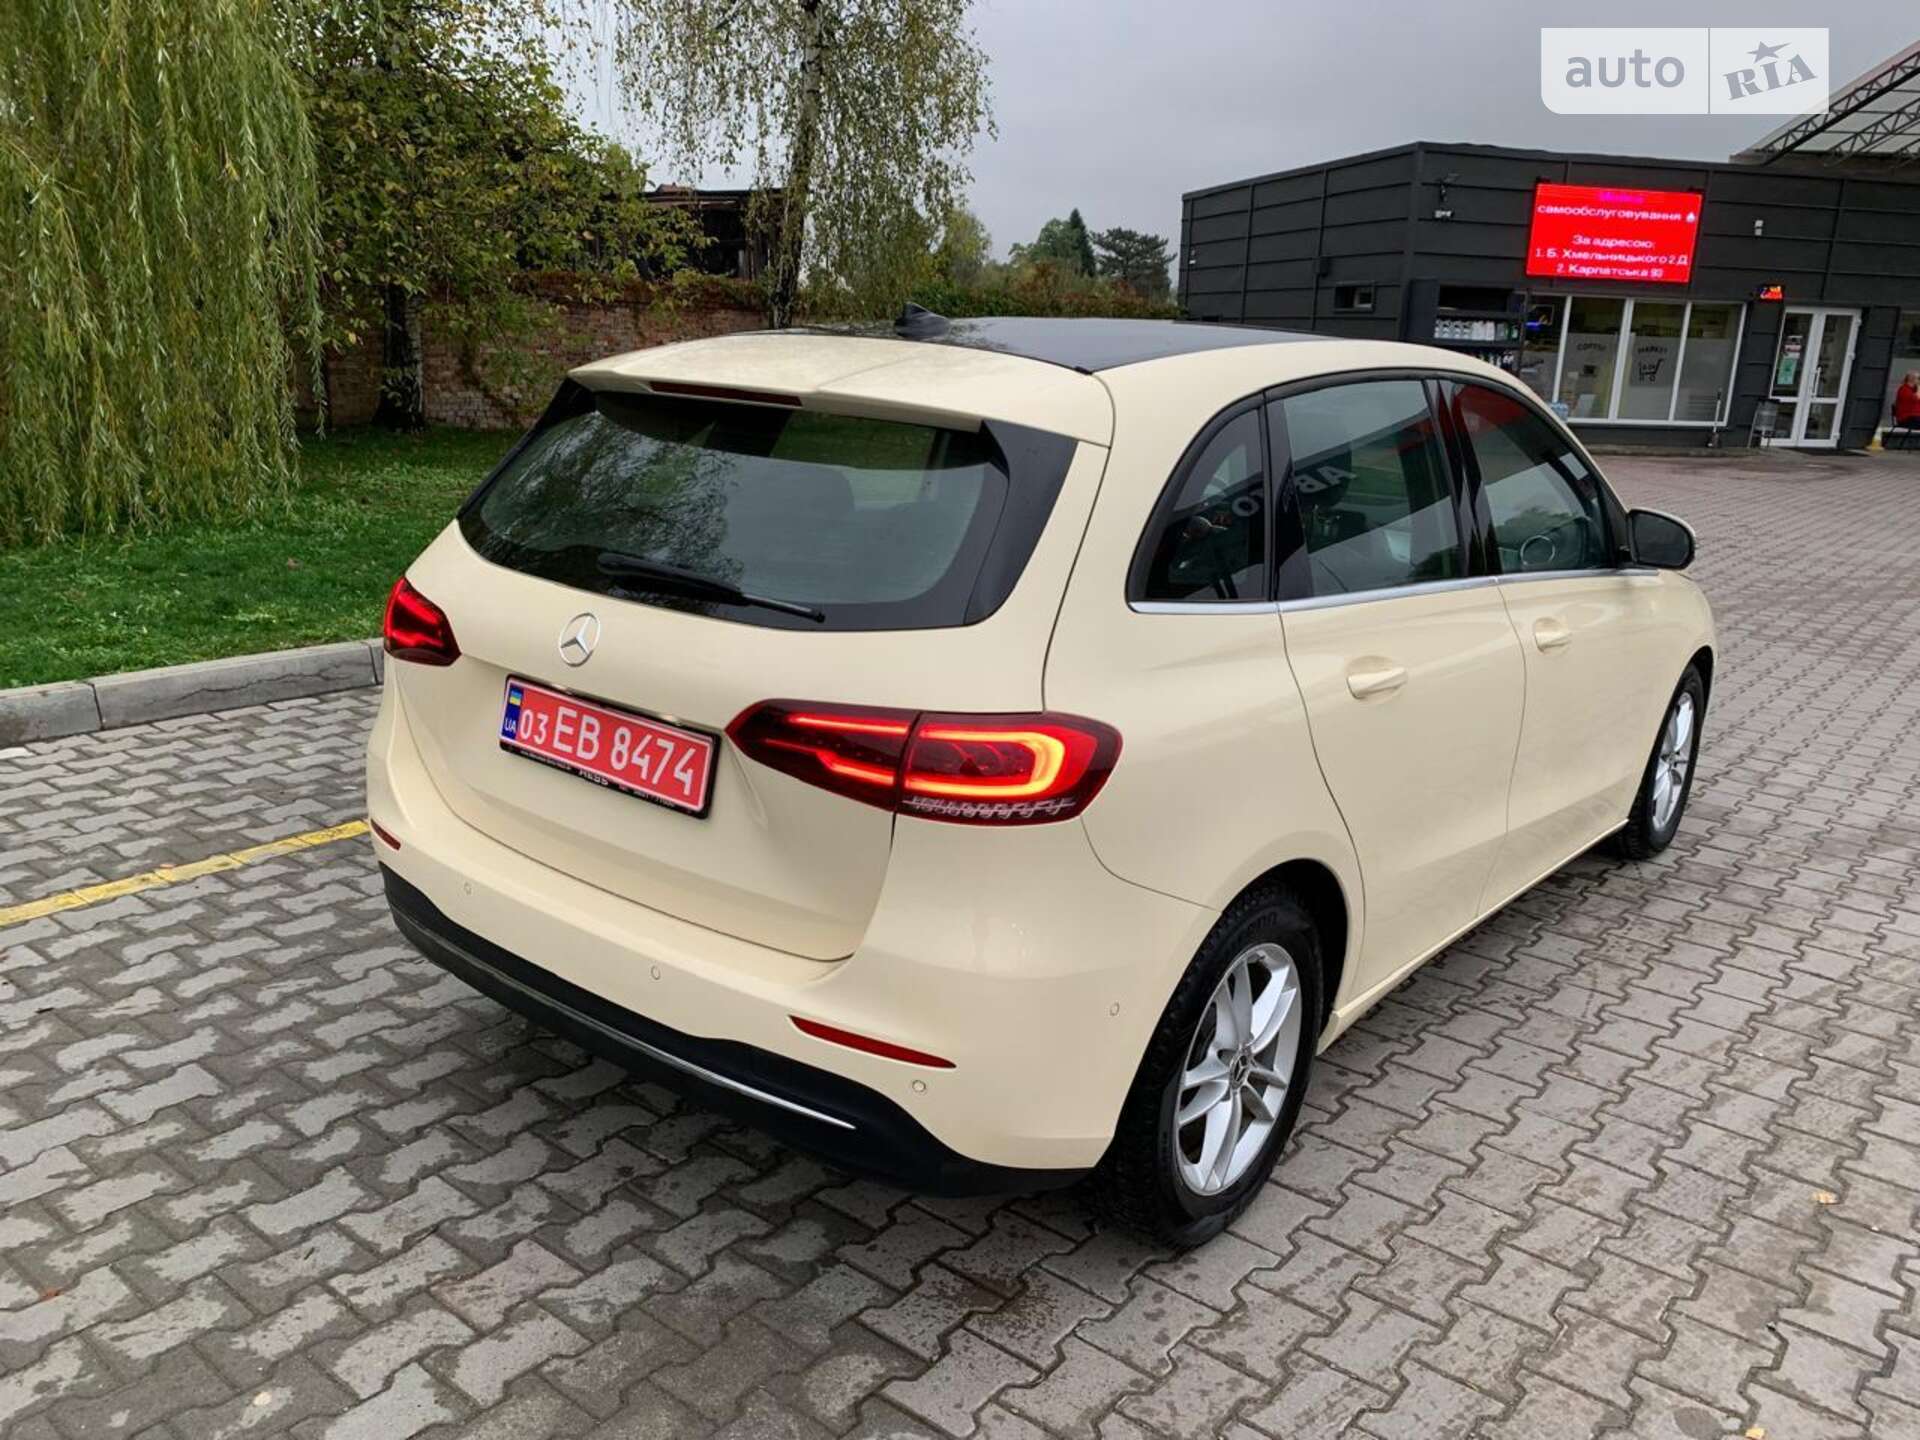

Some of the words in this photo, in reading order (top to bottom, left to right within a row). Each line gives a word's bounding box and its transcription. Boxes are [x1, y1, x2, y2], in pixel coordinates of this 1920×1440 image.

[1537, 204, 1682, 221] самообслуговування
[1572, 234, 1591, 246] За
[1563, 249, 1667, 264] Хмельницького
[1568, 264, 1648, 277] Карпатська
[504, 717, 517, 734] UA
[519, 709, 550, 746] 03
[552, 706, 600, 761] EB
[610, 726, 697, 797] 8474
